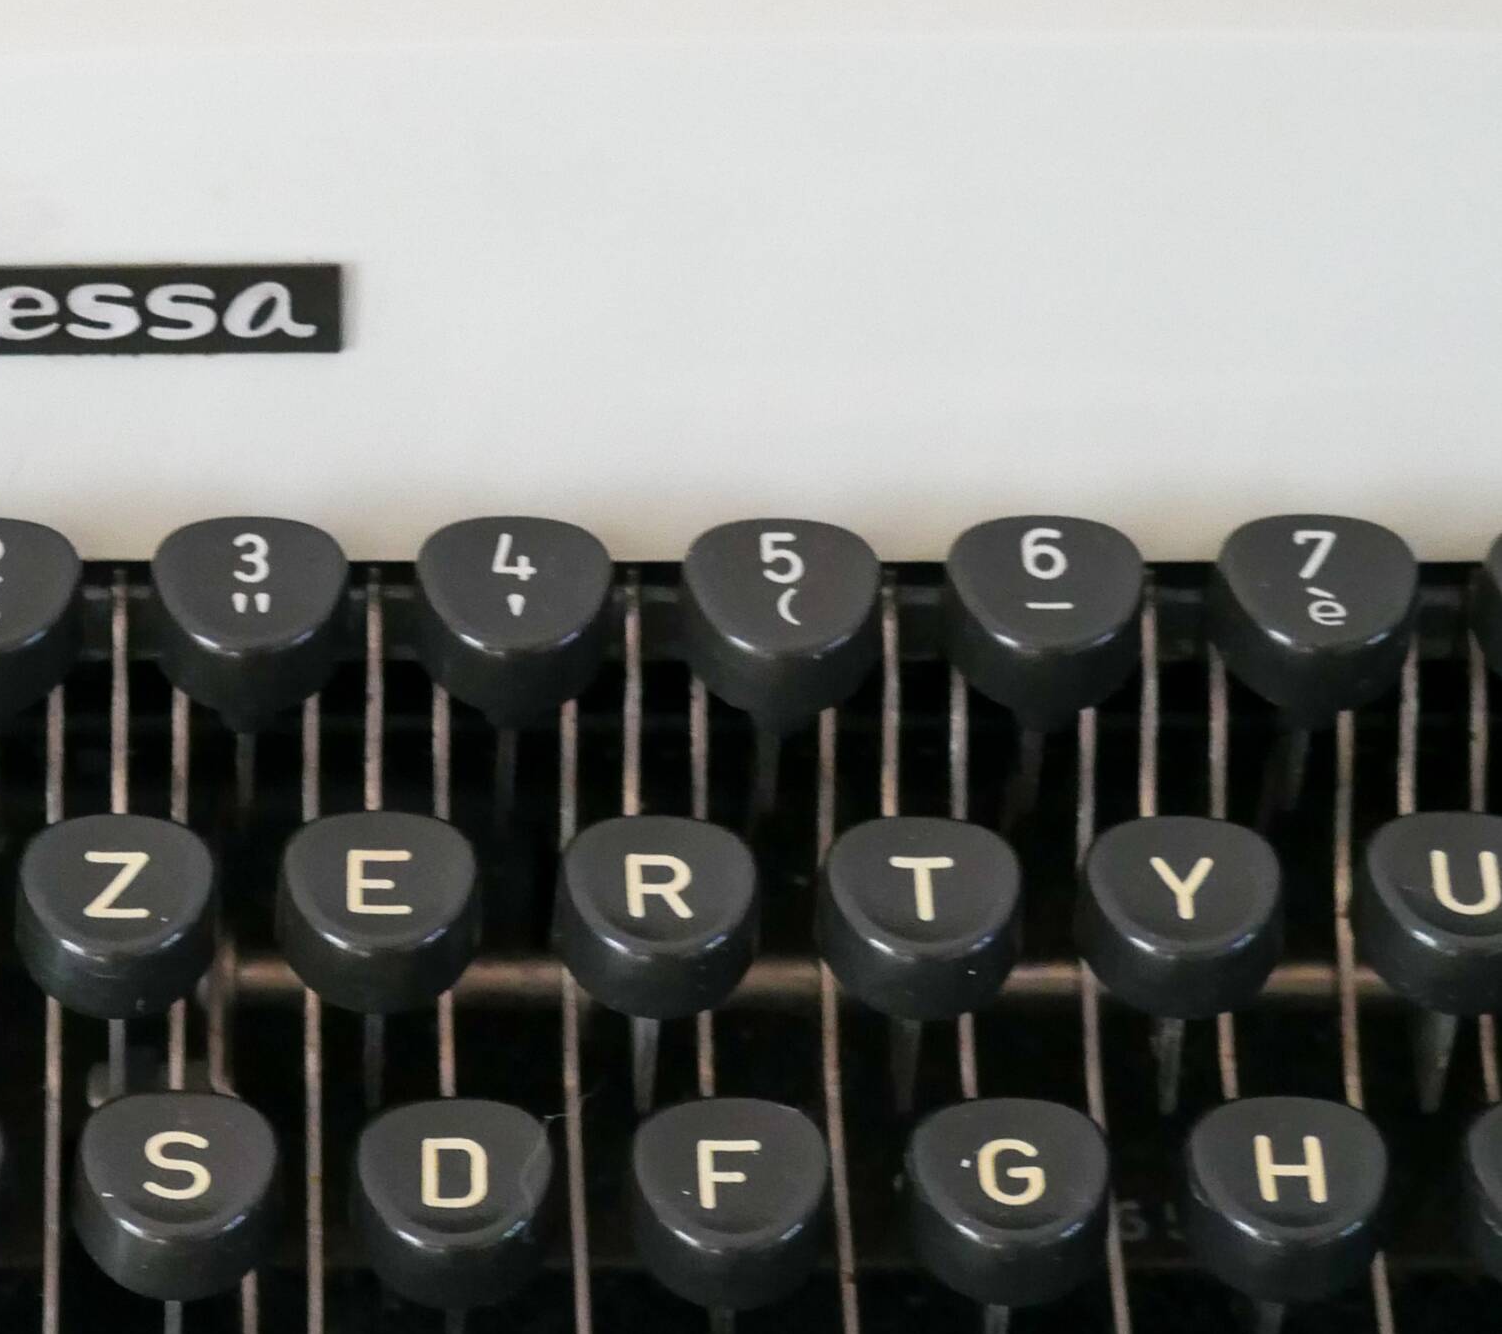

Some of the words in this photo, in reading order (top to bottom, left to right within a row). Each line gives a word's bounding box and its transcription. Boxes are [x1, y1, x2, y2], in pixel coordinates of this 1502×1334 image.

[233, 533, 269, 583] 3
[492, 534, 537, 580] 4
[760, 533, 804, 583] 5
[1022, 528, 1067, 579] 6
[1294, 530, 1336, 578] 7
[84, 852, 149, 918] Z
[347, 850, 412, 914] E
[625, 854, 693, 918] R
[890, 857, 953, 921] T
[1150, 857, 1213, 919] Y
[1431, 850, 1502, 915] U
[143, 1131, 211, 1199] S
[422, 1138, 487, 1208] D
[697, 1140, 761, 1209] F
[978, 1139, 1045, 1205] G
[1255, 1135, 1327, 1203] H
